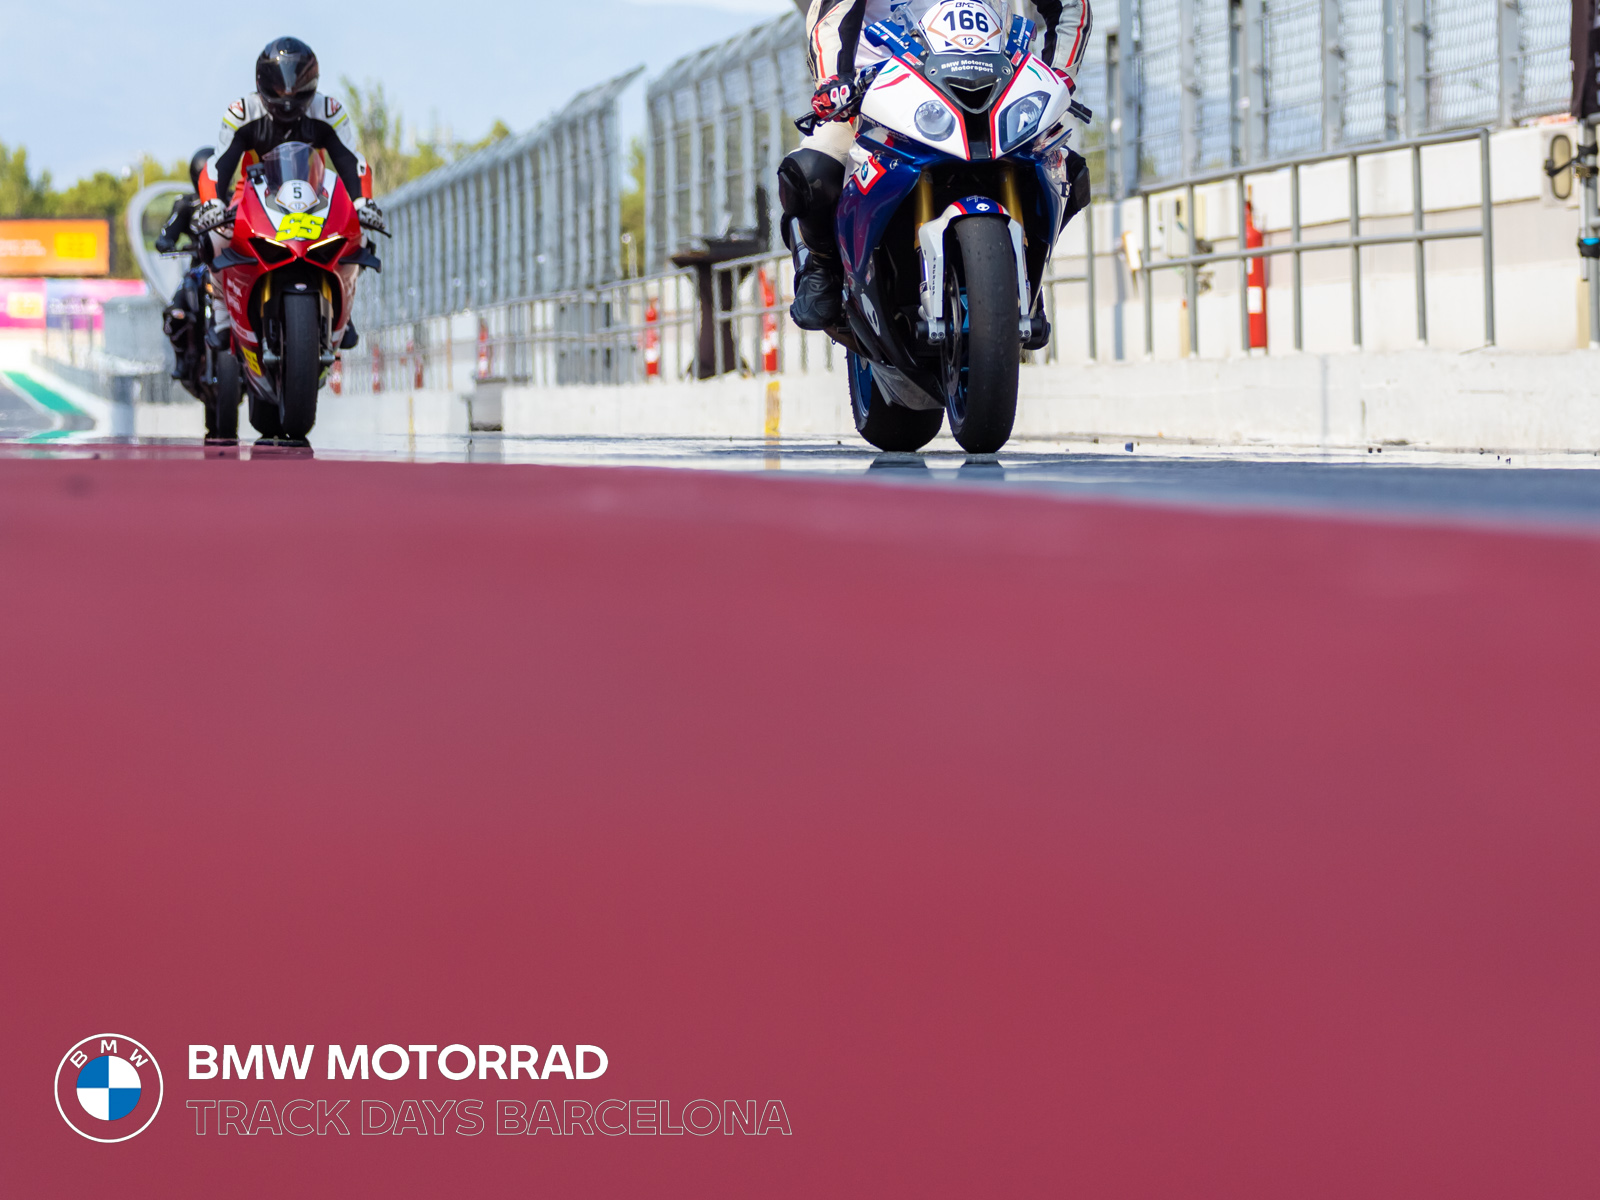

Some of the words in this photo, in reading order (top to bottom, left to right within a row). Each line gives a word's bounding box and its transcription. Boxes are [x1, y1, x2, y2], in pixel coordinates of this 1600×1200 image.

[943, 10, 989, 33] 166
[962, 37, 974, 46] 12
[941, 61, 960, 70] BMW
[961, 60, 994, 68] Motorrad
[951, 65, 994, 74] Motorsport
[293, 187, 302, 199] 5
[274, 212, 325, 242] 55
